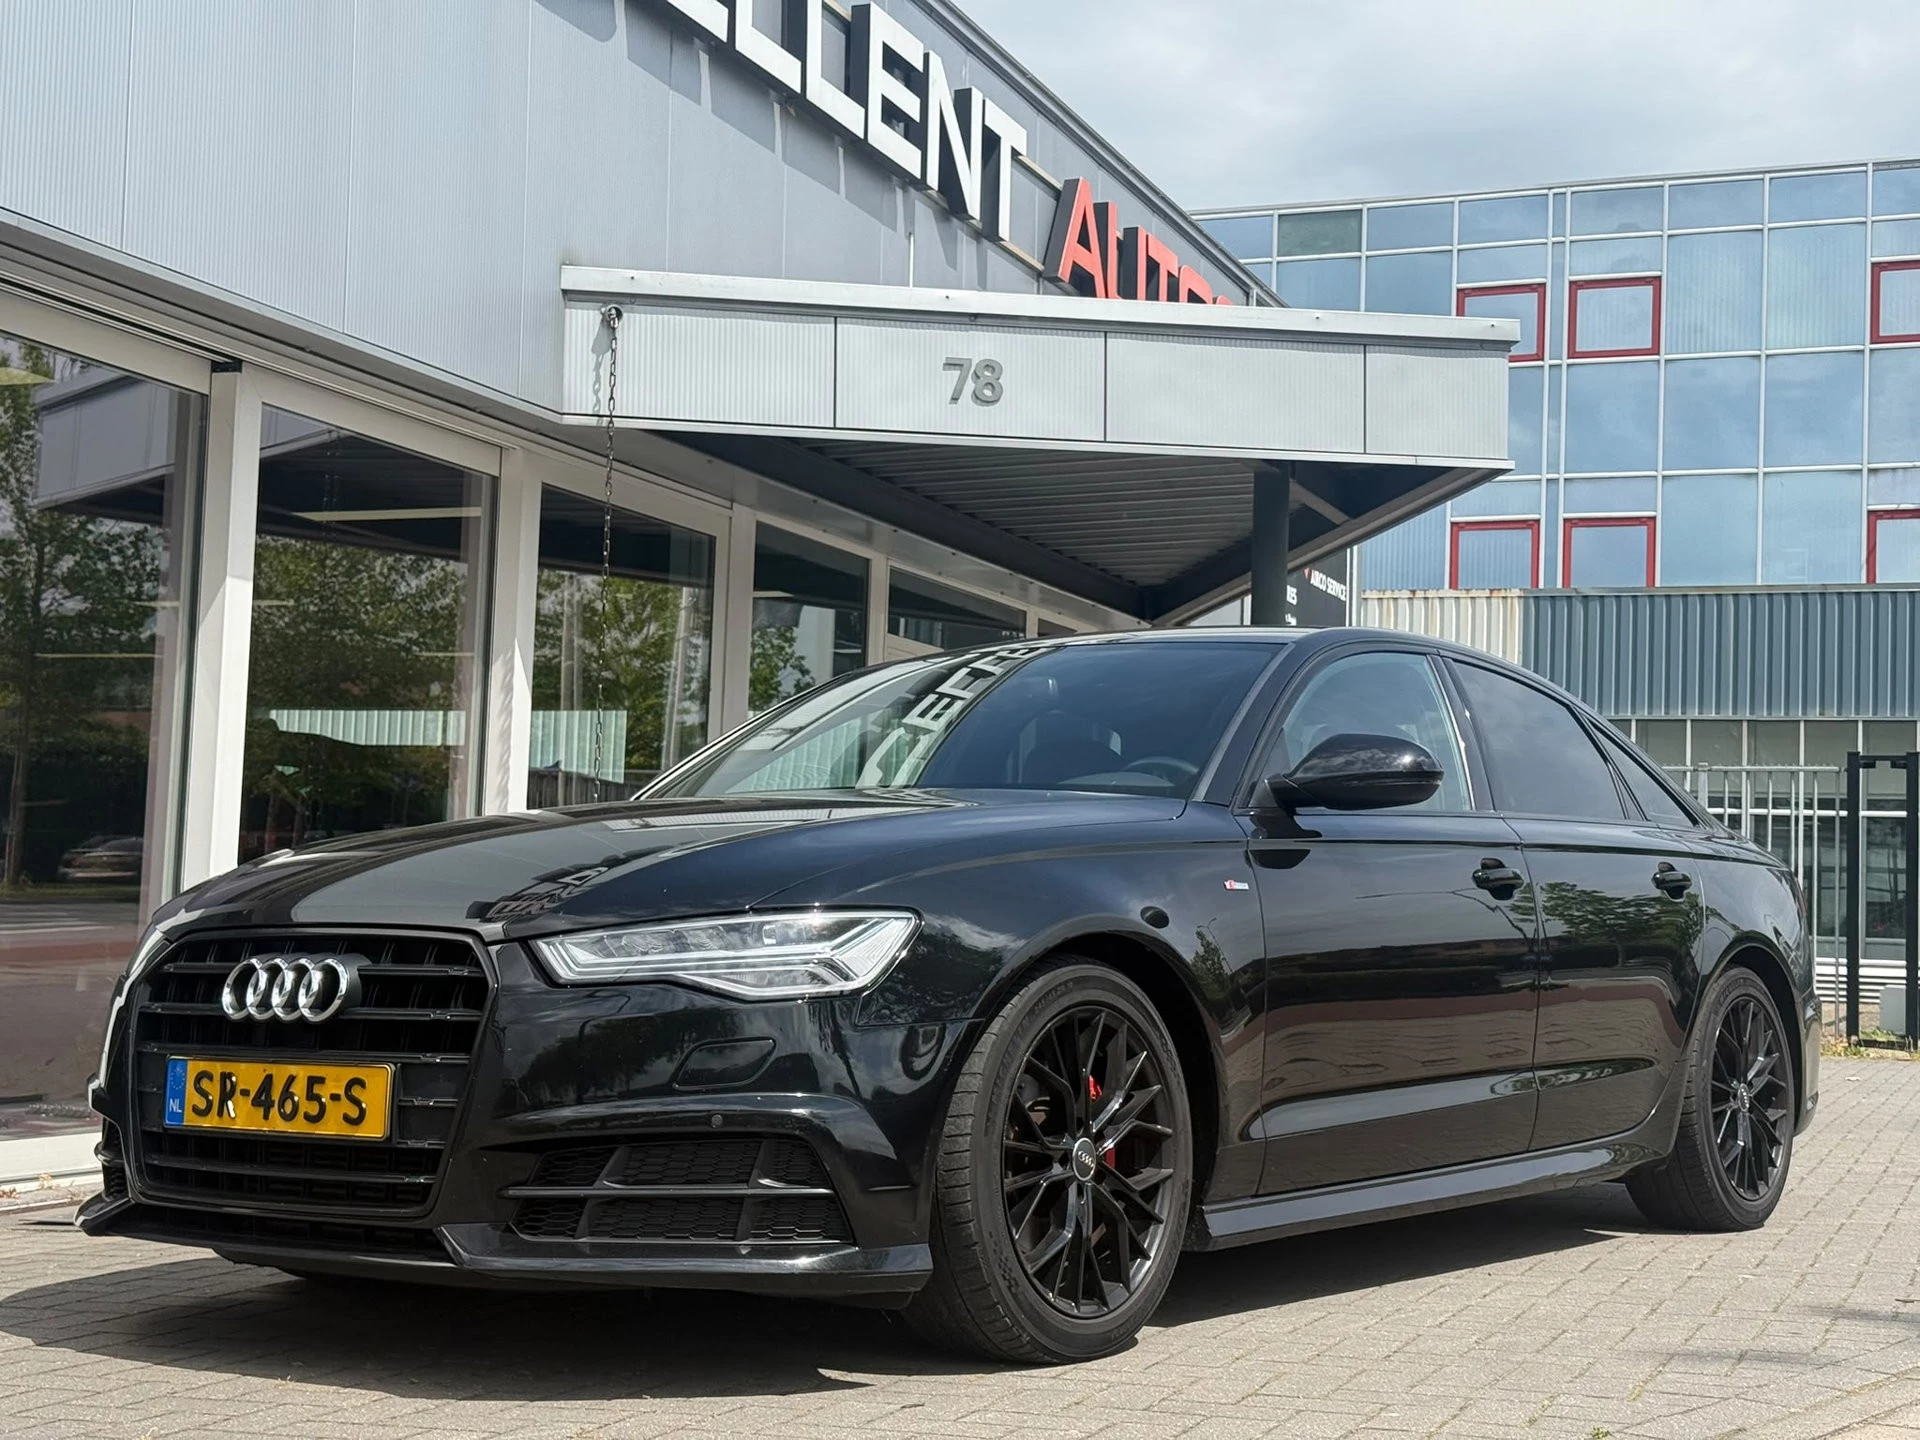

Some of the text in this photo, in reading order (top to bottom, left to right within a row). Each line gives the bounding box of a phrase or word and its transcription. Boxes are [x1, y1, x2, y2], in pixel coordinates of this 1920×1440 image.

[942, 357, 1004, 406] 78
[169, 1098, 182, 1112] NL
[192, 1070, 367, 1126] SR-465-S
